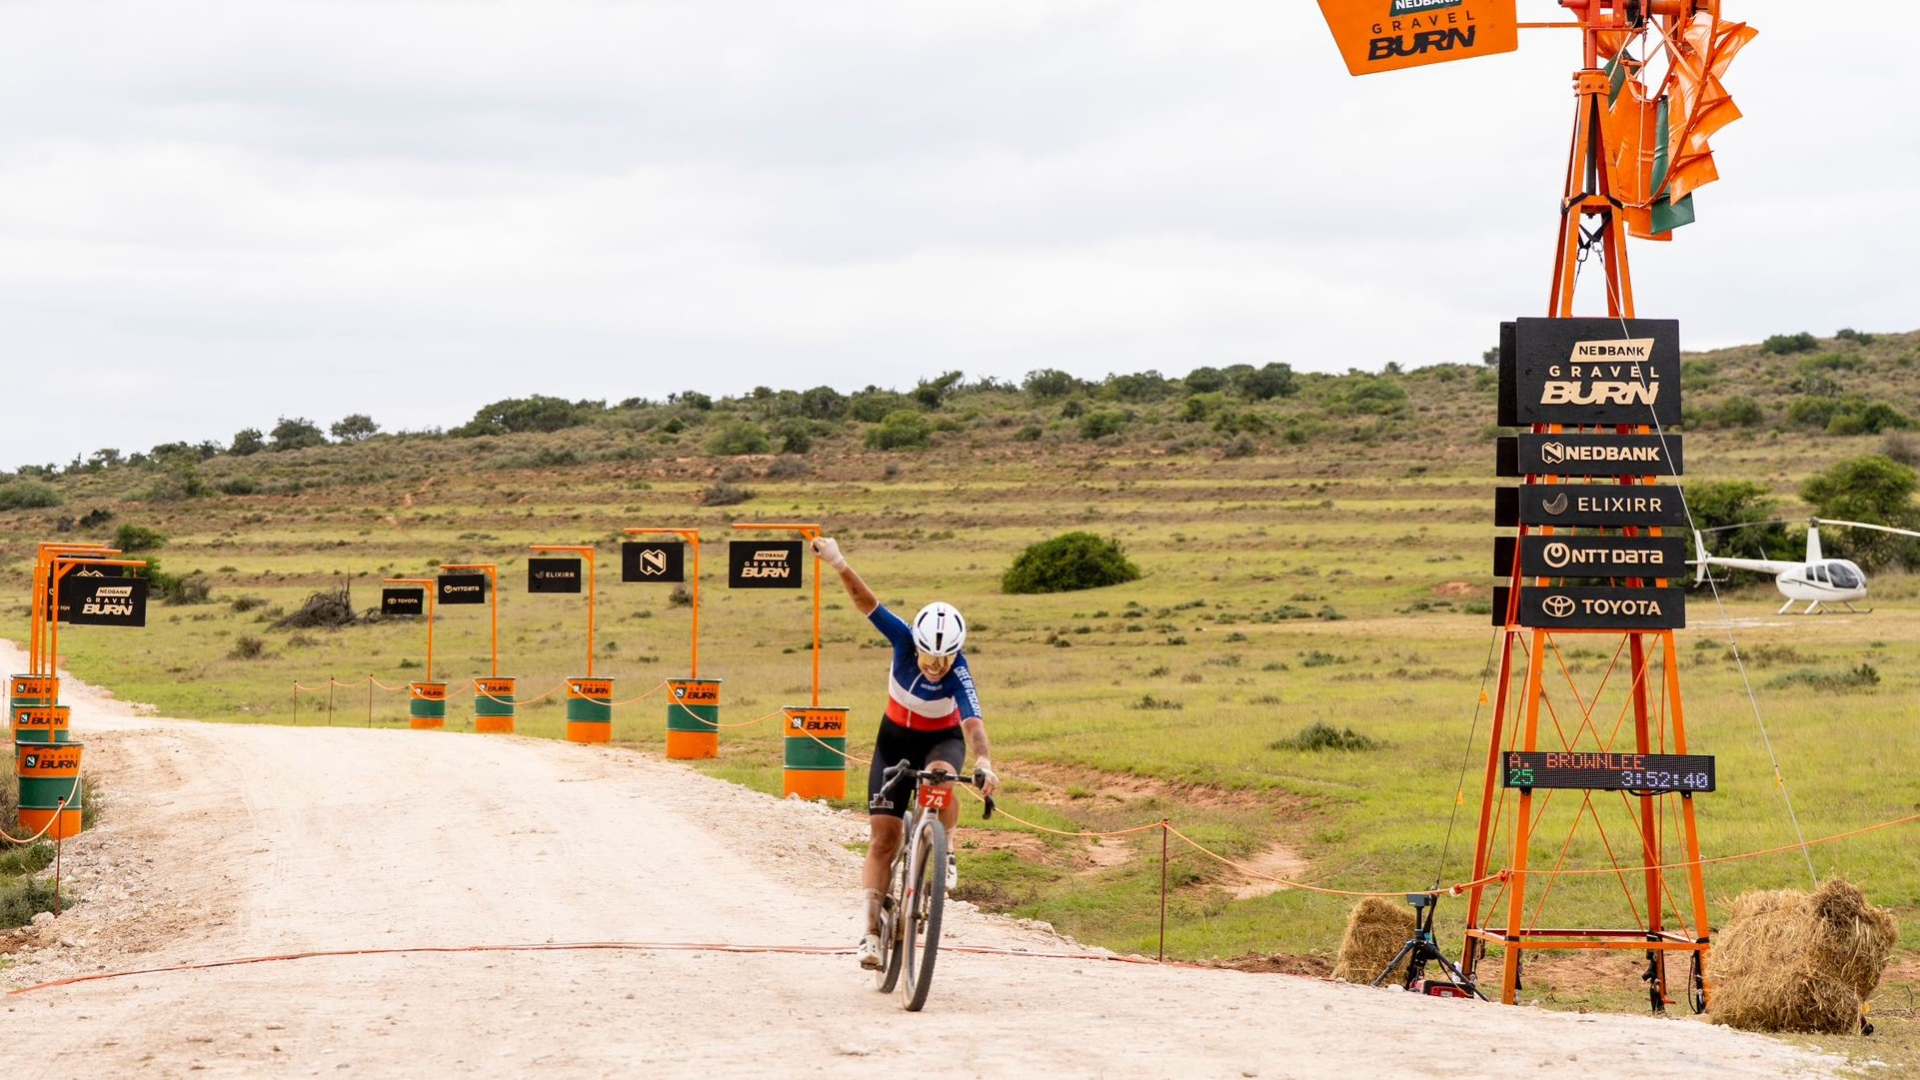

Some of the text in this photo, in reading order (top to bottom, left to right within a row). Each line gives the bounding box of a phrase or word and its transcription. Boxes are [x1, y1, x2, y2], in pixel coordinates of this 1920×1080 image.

[1372, 10, 1475, 34] GRAVEL
[1368, 25, 1476, 60] BURN
[1578, 346, 1645, 356] NEDBANK
[1549, 365, 1659, 378] GRAVEL
[1540, 381, 1659, 405] BURN
[1565, 446, 1660, 461] NEDBANK
[1577, 497, 1662, 512] ELIXIRR
[1572, 549, 1609, 563] NTT
[741, 567, 790, 578] BURN
[82, 604, 133, 616] BURN
[1581, 599, 1662, 616] TOYOTA
[807, 722, 842, 730] BURN
[40, 760, 78, 769] BURN
[1509, 753, 1646, 770] A. BROWNLEE
[1510, 769, 1534, 785] 25
[1621, 771, 1708, 788] 3:52:40
[925, 795, 943, 806] 74
